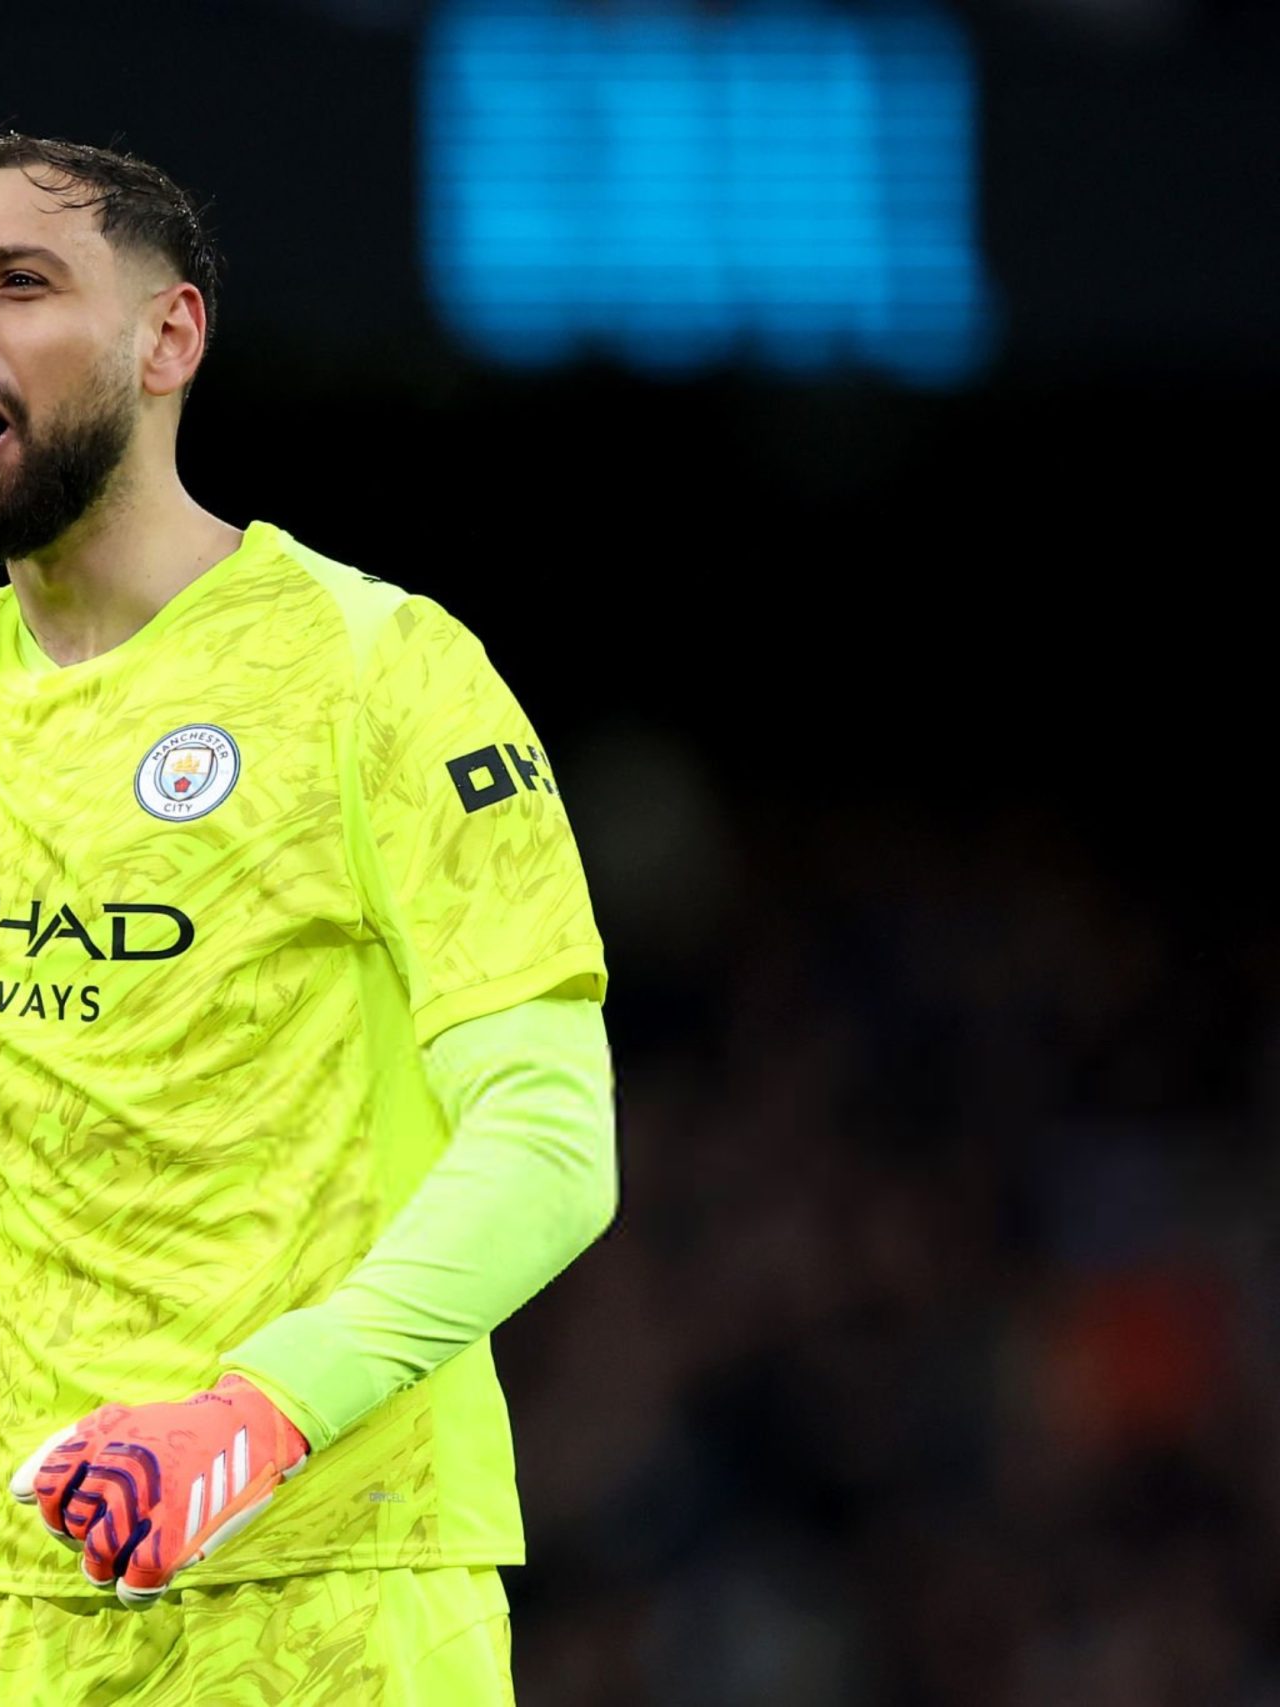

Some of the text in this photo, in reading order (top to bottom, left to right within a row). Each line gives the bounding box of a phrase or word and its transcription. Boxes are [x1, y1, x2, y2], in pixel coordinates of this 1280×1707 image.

[151, 732, 230, 762] MANCHESTER
[445, 743, 561, 814] OK
[163, 803, 194, 814] CITY
